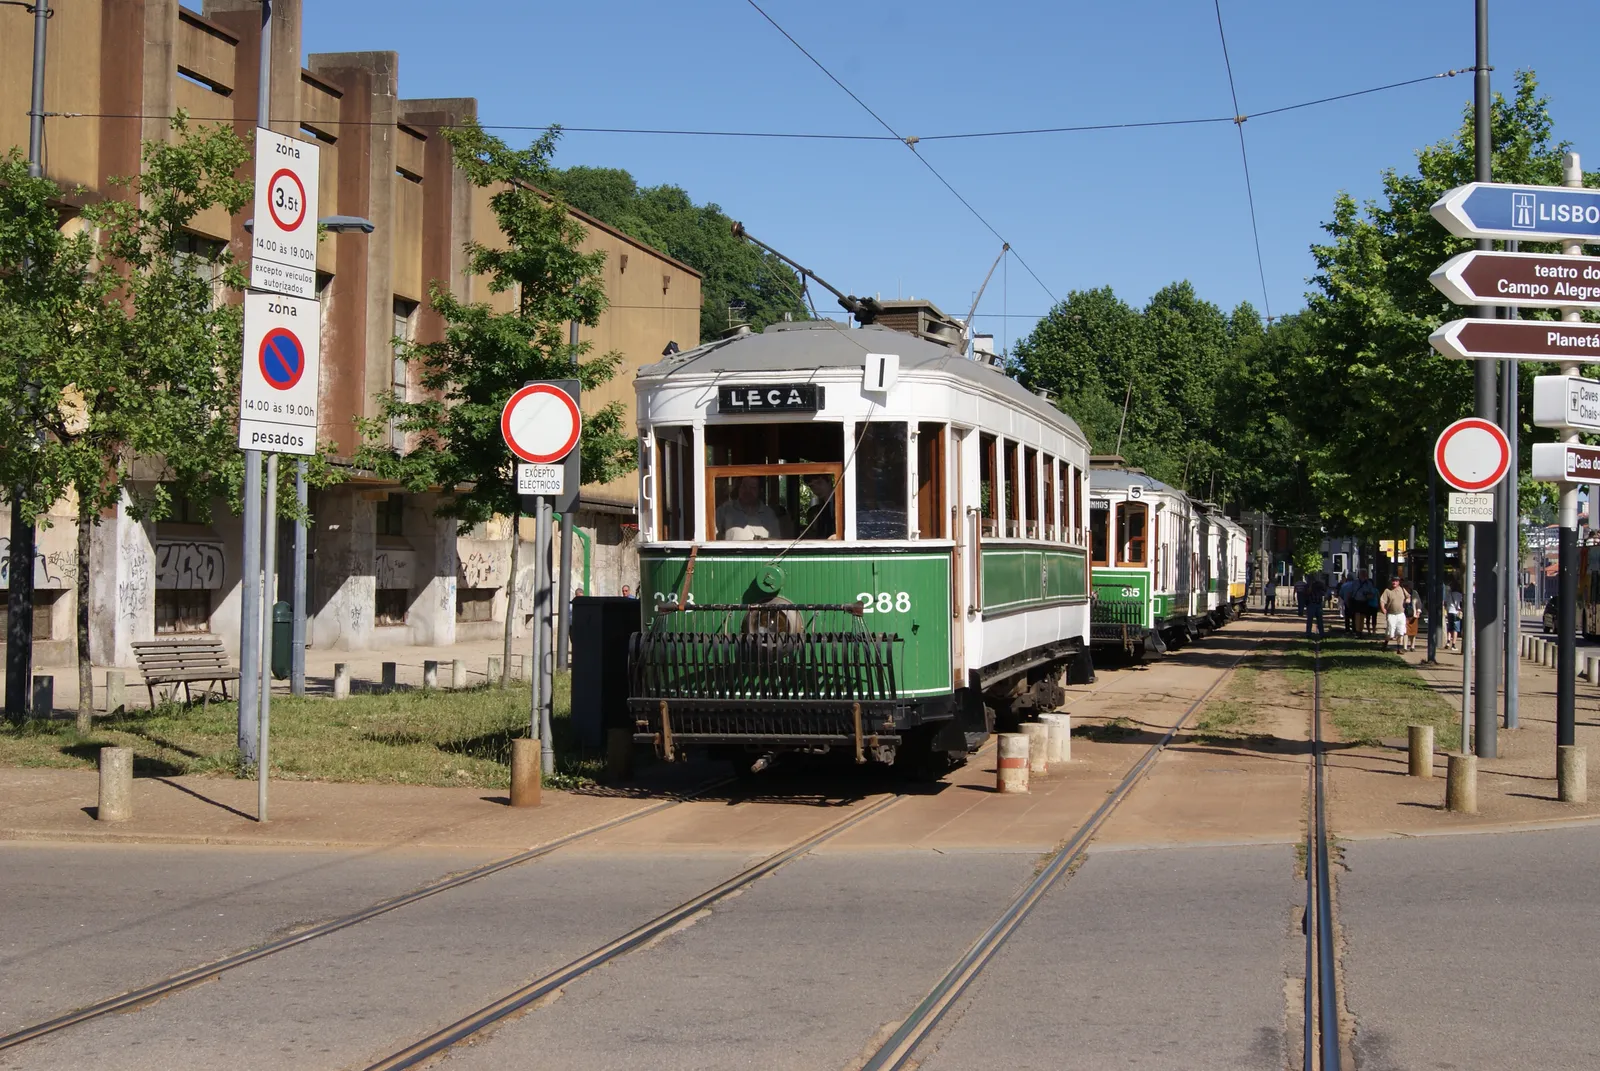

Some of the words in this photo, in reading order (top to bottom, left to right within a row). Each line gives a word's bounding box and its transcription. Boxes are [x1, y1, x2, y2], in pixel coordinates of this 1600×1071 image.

[276, 142, 300, 159] zona
[276, 187, 298, 212] 3,5t
[1540, 203, 1600, 224] LISBO
[256, 237, 276, 252] 14.00
[280, 243, 288, 254] às
[290, 246, 314, 260] 19.00h
[255, 264, 282, 276] excepto
[1534, 264, 1578, 278] teatro
[1583, 266, 1600, 280] do
[264, 278, 304, 294] autorizados
[1497, 278, 1549, 297] Campo
[1554, 282, 1600, 300] Alegre
[268, 302, 297, 316] zona
[1547, 332, 1600, 348] Planetá
[1580, 386, 1598, 402] Caves
[244, 399, 270, 412] 14.00
[272, 402, 282, 413] às
[286, 404, 314, 417] 19.00h
[1580, 404, 1600, 420] Chais-
[252, 432, 304, 447] pesados
[1576, 454, 1592, 470] Casa
[525, 468, 556, 478] EXCEPTO
[1131, 486, 1141, 499] 5
[1456, 496, 1488, 505] EXCEPTO
[856, 592, 911, 614] 288
